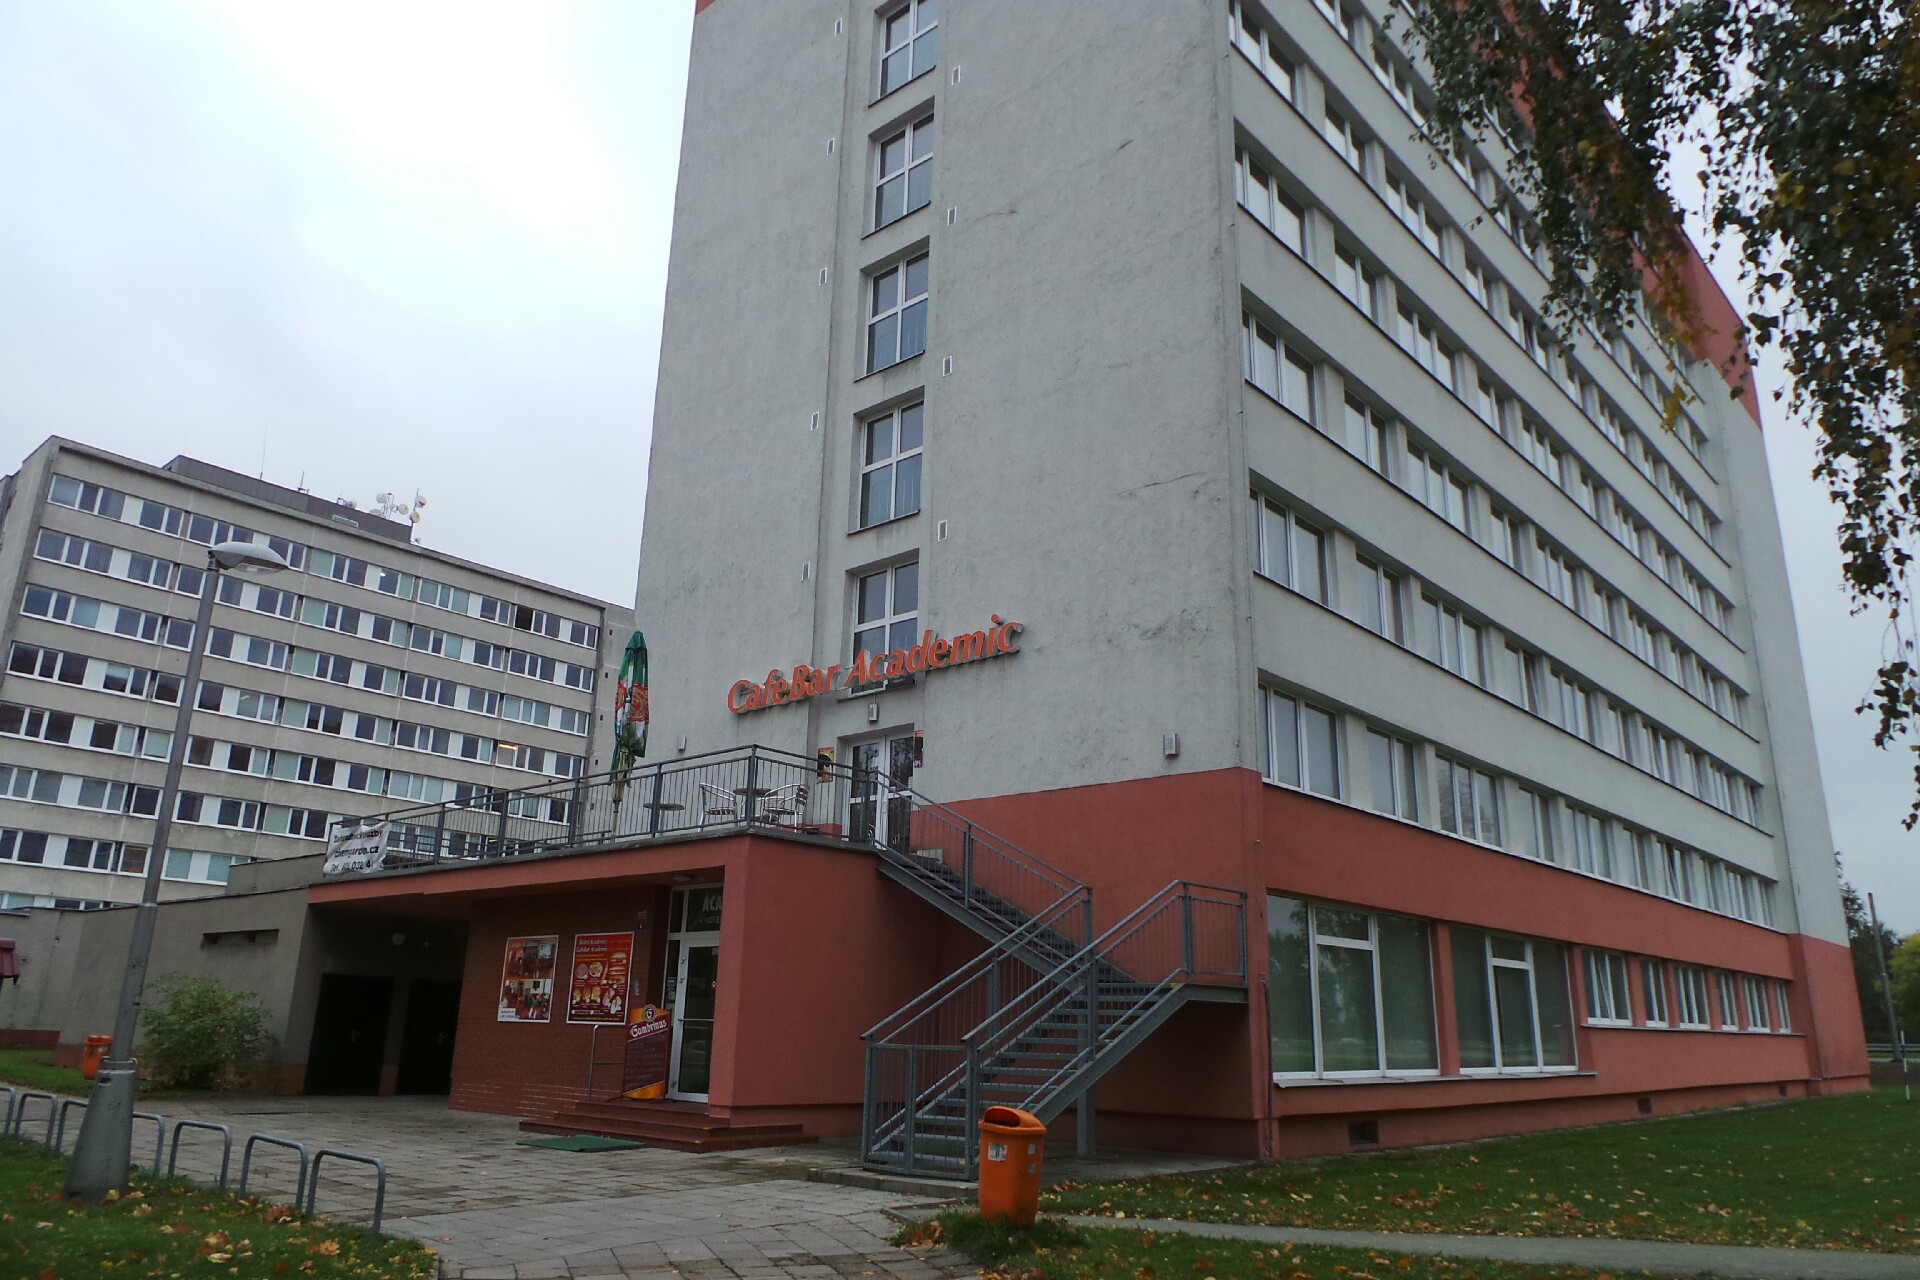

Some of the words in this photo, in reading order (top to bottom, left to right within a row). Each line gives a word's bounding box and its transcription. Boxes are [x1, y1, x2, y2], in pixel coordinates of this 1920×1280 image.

[727, 663, 840, 714] CafeBar
[844, 613, 1025, 688] Academic
[704, 915, 721, 924] HOTE
[630, 1018, 667, 1038] Gambrinus
